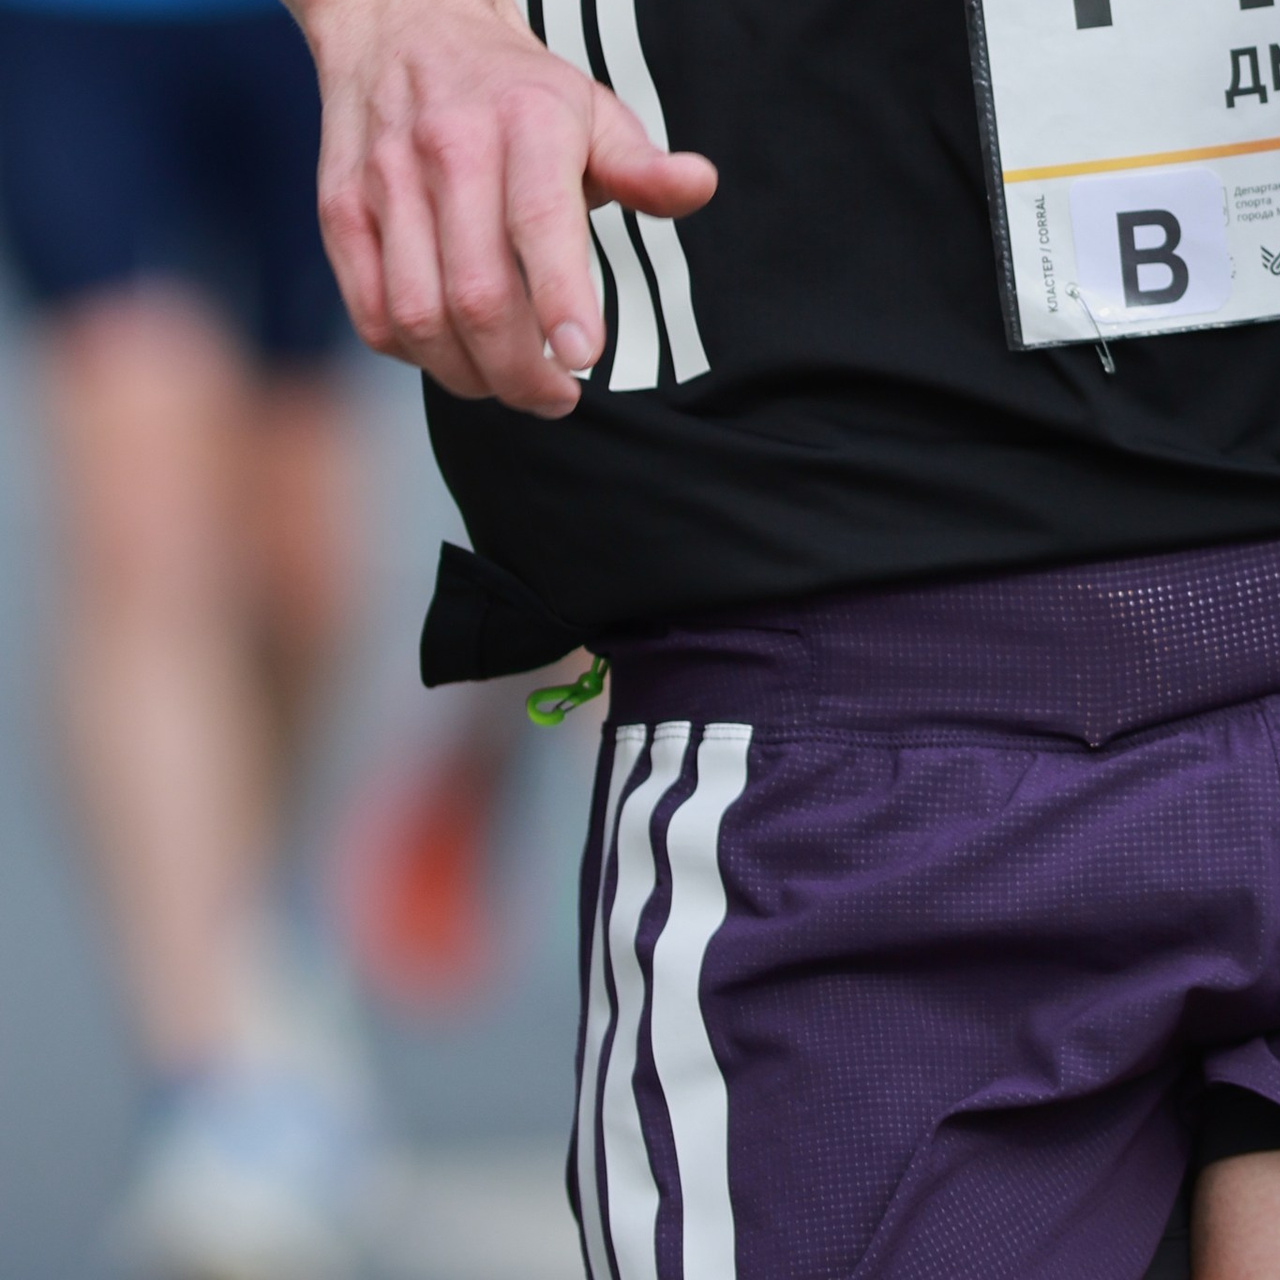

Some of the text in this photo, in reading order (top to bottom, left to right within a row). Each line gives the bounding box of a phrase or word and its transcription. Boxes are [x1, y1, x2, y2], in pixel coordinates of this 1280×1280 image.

[1235, 196, 1272, 210] спорта
[1237, 208, 1274, 222] города
[1035, 194, 1050, 245] CORRAL
[1041, 256, 1058, 313] КЛАСТЕР
